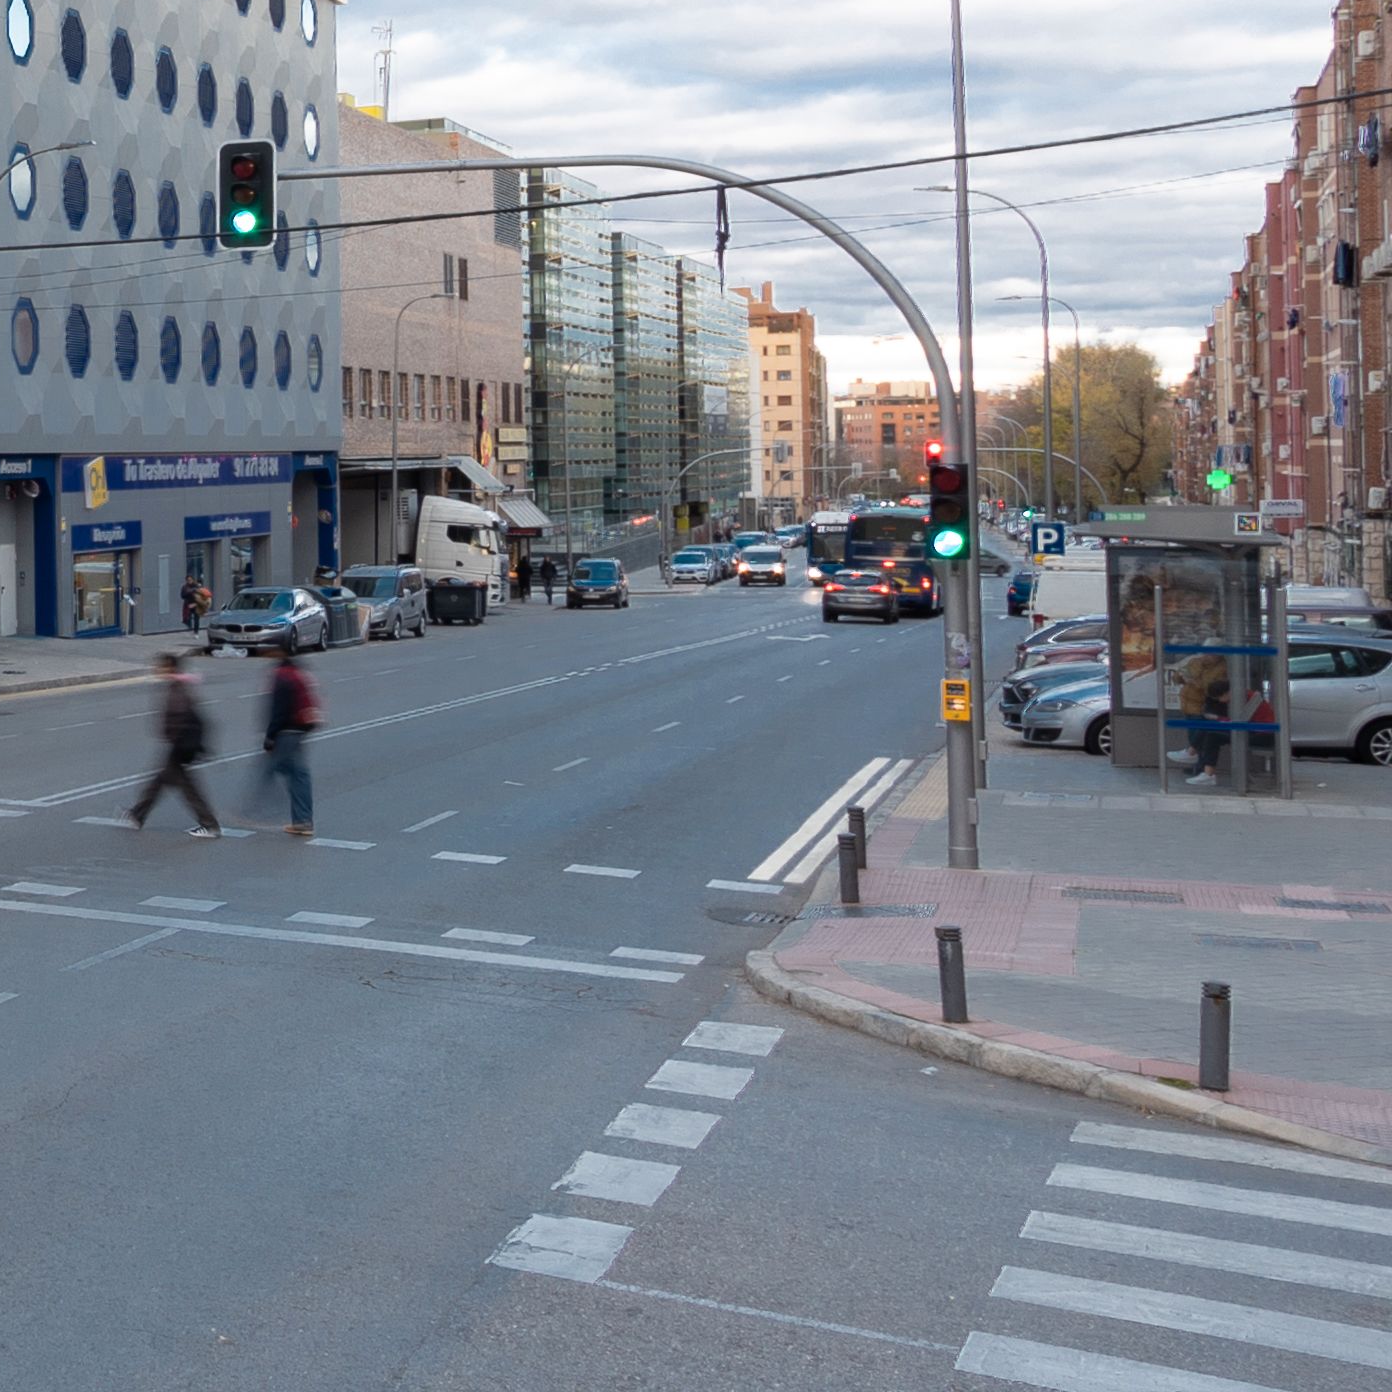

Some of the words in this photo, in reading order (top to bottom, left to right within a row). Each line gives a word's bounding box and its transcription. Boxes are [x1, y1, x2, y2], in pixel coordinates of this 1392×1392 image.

[123, 459, 138, 482] Tu
[137, 458, 176, 481] Trastero
[188, 457, 220, 484] Alquiler
[1037, 527, 1058, 552] P
